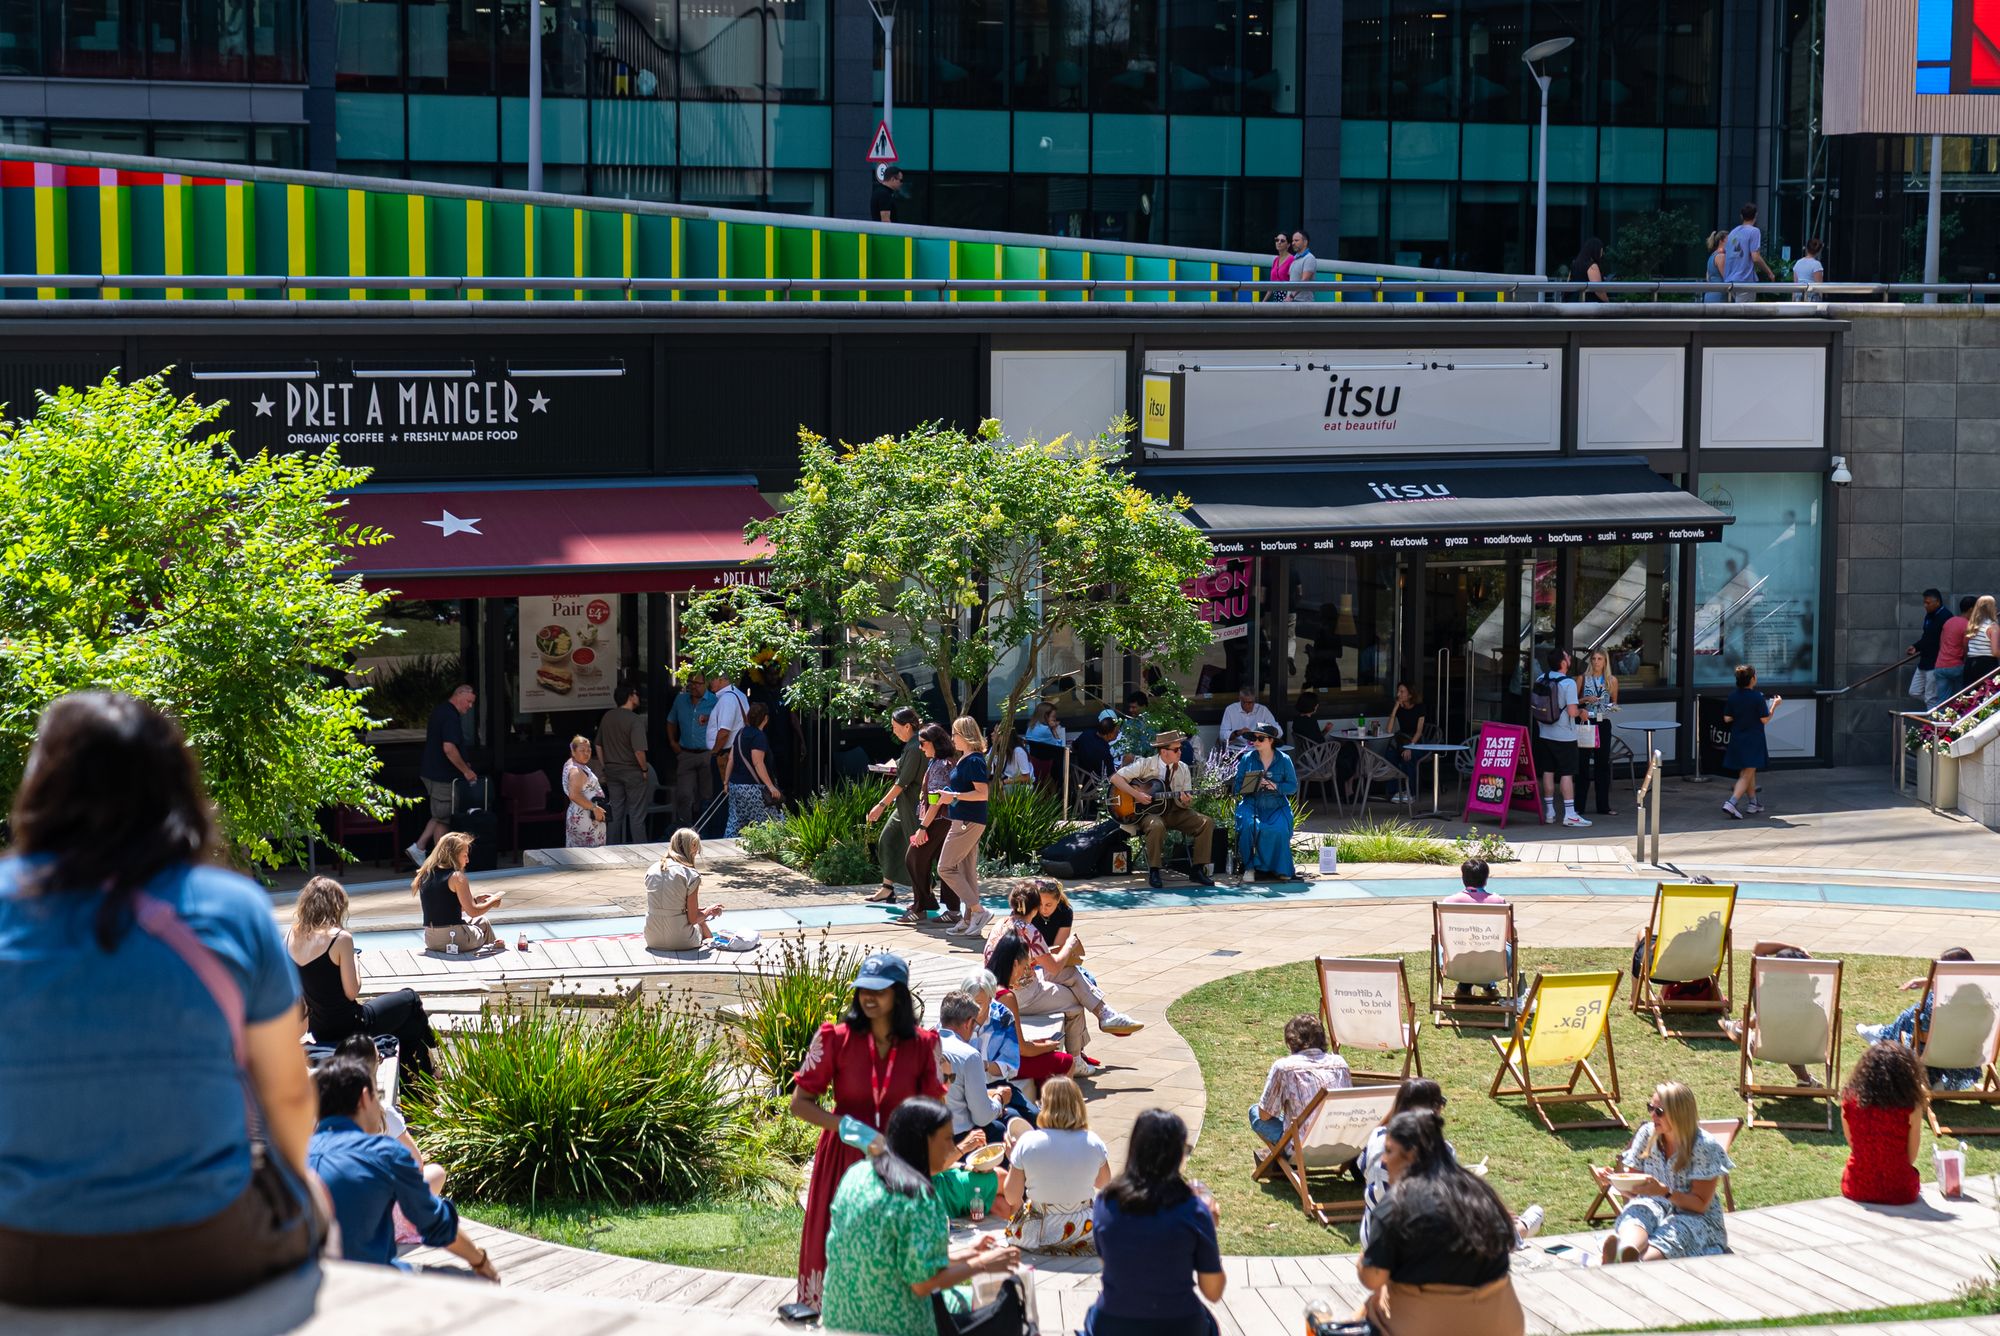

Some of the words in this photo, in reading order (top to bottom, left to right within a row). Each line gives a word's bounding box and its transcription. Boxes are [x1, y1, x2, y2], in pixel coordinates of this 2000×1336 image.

[286, 382, 354, 427] PRET
[366, 381, 383, 426] A
[399, 379, 519, 426] MANGER
[1324, 374, 1401, 417] itsu
[1149, 397, 1166, 417] itsu
[1324, 422, 1342, 431] eat
[1345, 420, 1397, 431] beautiful
[287, 433, 341, 444] ORGANIC
[343, 432, 384, 443] COFFEE
[403, 432, 450, 442] FRESHLY
[452, 431, 484, 442] MADE
[486, 430, 518, 440] FOOD
[1367, 482, 1450, 499] itsu
[1260, 541, 1298, 551] bao'buns
[1314, 540, 1334, 549] sushi
[1350, 539, 1373, 550] soups
[1390, 536, 1429, 547] rice'bowls
[1445, 536, 1468, 547] gyoza
[1484, 534, 1532, 544] noodle'bowls
[1548, 533, 1582, 542] bao'buns
[1598, 531, 1616, 541] sushi
[1632, 531, 1654, 541] soups
[1669, 528, 1705, 538] rice'bowls
[748, 572, 754, 586] A
[1215, 569, 1249, 592] ON
[552, 602, 584, 617] Pair
[1200, 594, 1249, 623] ENU
[1224, 626, 1246, 637] caught
[1710, 724, 1731, 744] itsu
[1486, 737, 1516, 749] TASTE
[1483, 750, 1496, 758] THE
[1496, 750, 1513, 758] BEST
[1481, 758, 1493, 768] OF
[1494, 758, 1512, 768] ITSU
